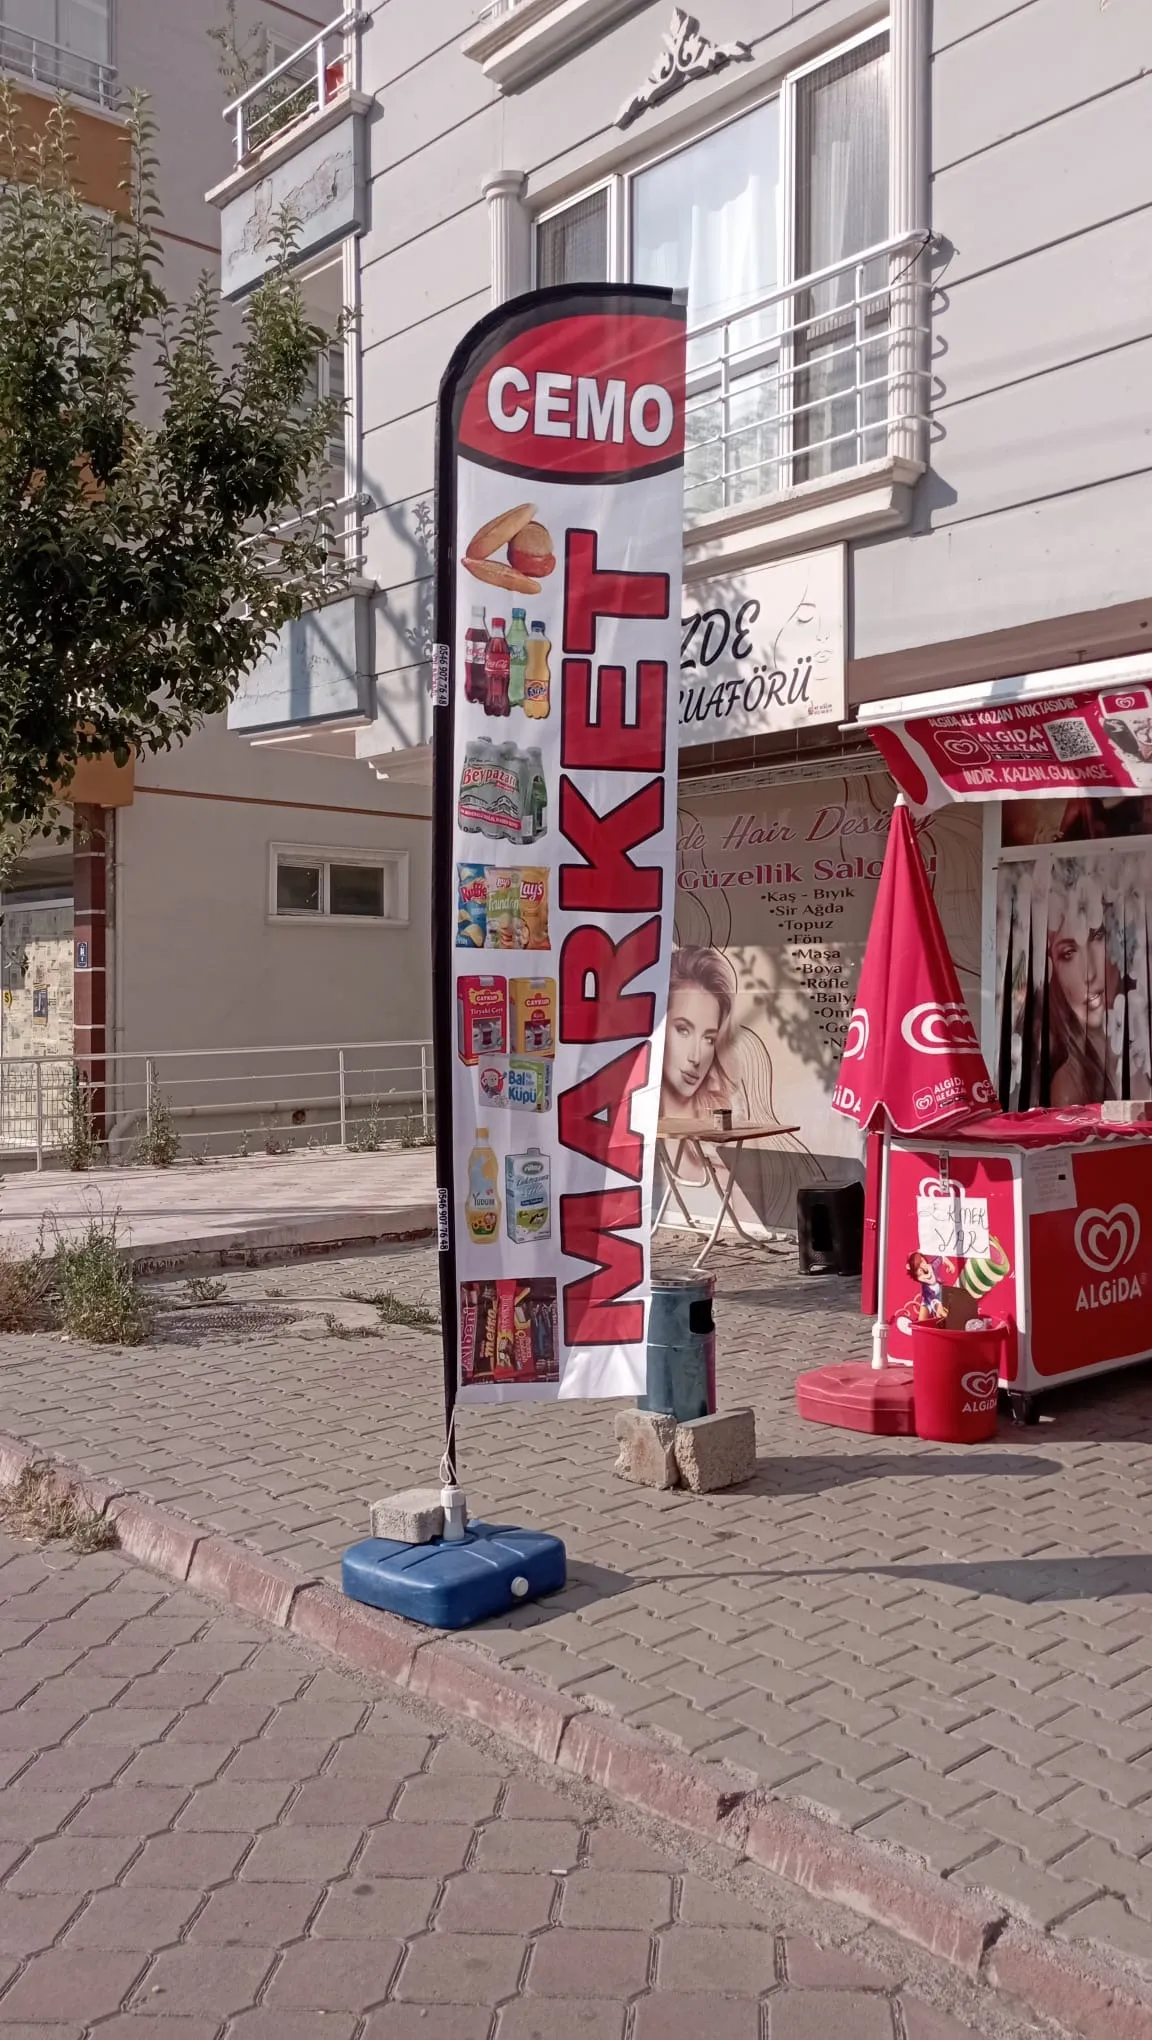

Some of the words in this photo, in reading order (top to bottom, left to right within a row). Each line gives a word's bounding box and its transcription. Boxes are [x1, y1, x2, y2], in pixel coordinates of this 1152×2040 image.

[487, 366, 675, 447] CEMO
[439, 646, 448, 664] 0546
[439, 666, 448, 682] 907
[679, 656, 812, 725] UAFÖRÜ
[977, 709, 1013, 724] KAZAN
[721, 815, 797, 850] Hair
[677, 862, 803, 890] Güzellik
[767, 891, 796, 903] Kaş
[814, 887, 855, 901] Bıyık
[775, 905, 798, 916] Sir
[802, 902, 844, 916] Ağda
[784, 919, 834, 932] Topuz
[558, 527, 670, 1347] MARKET
[794, 933, 823, 945] Fön
[798, 948, 841, 961] Maşa
[802, 963, 842, 976] Boya
[807, 978, 849, 989] Röfle
[508, 1071, 526, 1085] Bal
[508, 1087, 537, 1104] Küpü
[438, 1189, 447, 1208] 0546
[439, 1210, 448, 1225] 907
[439, 1228, 448, 1238] 76
